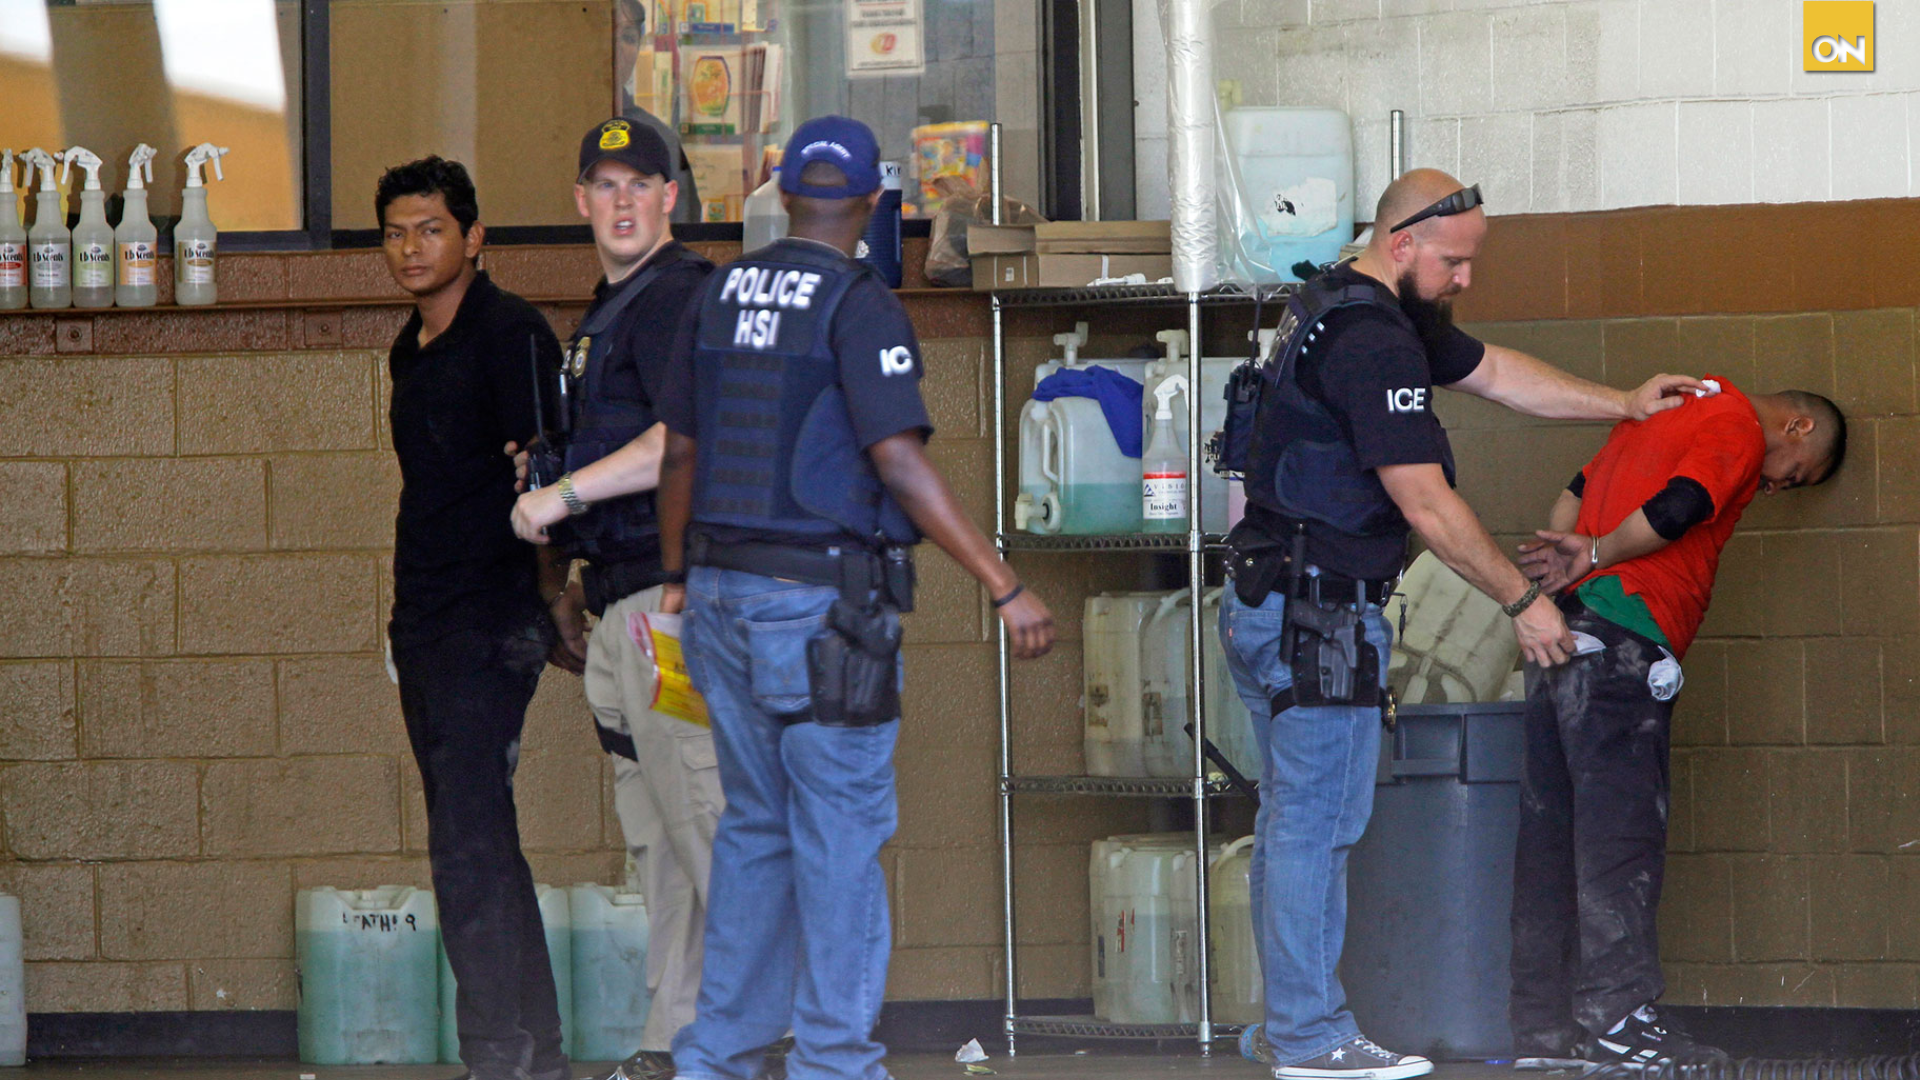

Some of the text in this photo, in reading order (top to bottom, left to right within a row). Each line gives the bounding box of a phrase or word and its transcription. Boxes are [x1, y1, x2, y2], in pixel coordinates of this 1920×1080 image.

[719, 266, 822, 309] POLICE
[733, 309, 781, 349] HSI
[1386, 387, 1427, 413] ICE
[1150, 502, 1178, 512] Insight
